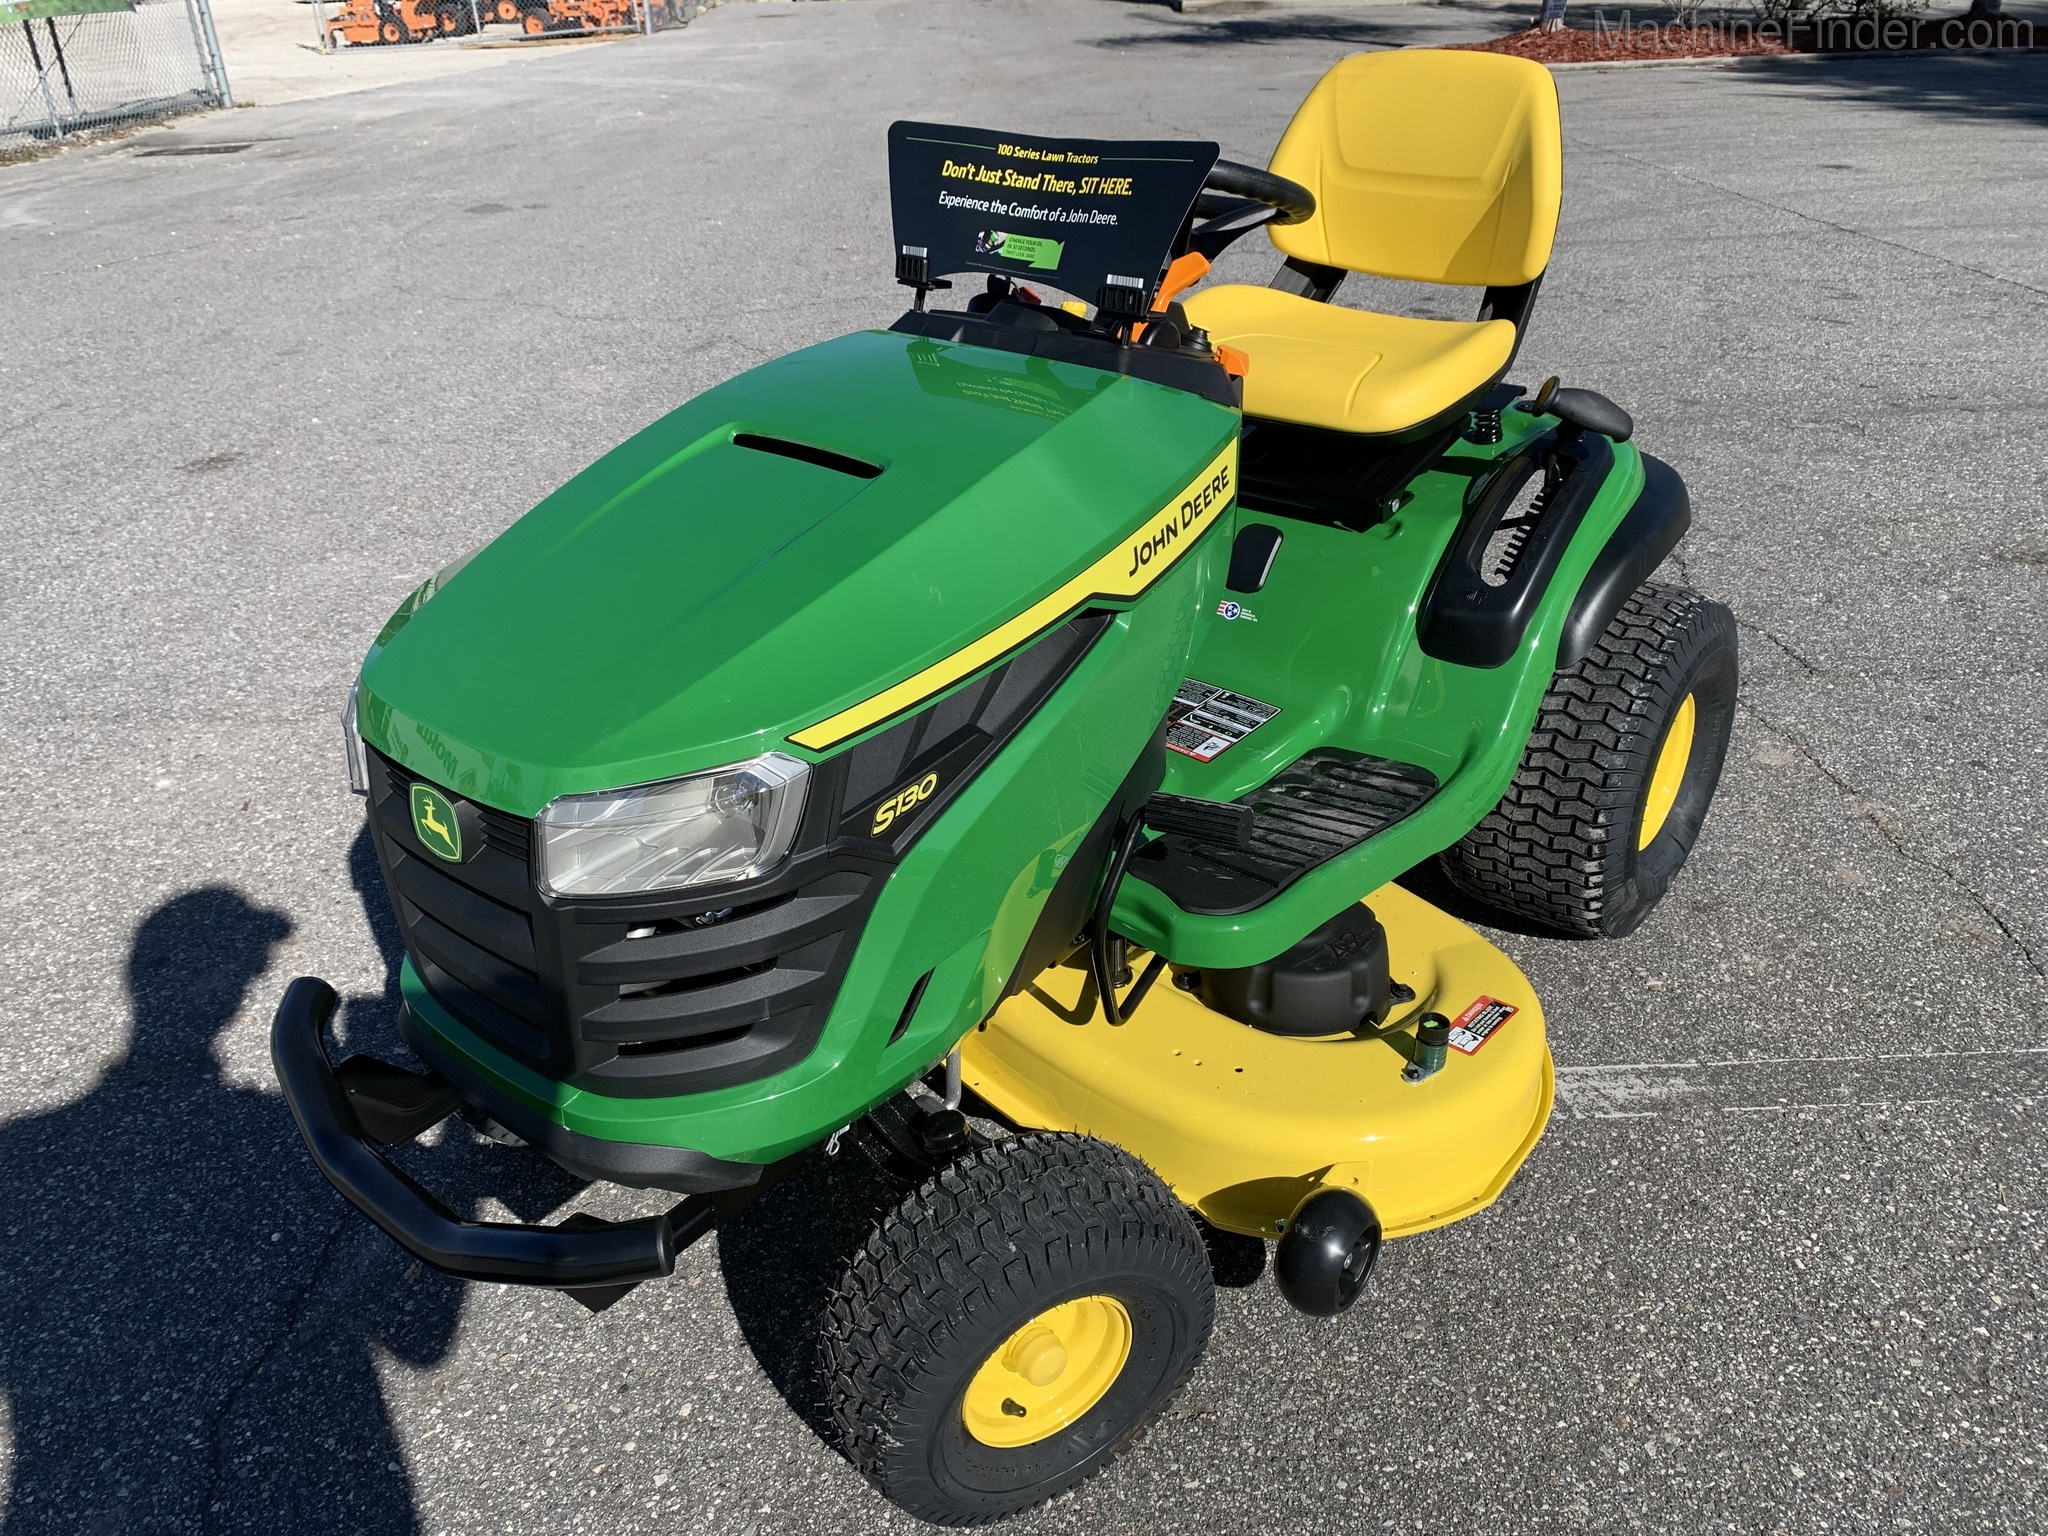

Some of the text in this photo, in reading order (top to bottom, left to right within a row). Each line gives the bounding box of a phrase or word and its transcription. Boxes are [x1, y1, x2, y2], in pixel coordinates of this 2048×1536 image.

[997, 143, 1099, 164] 100 Series Lawn Tractors
[942, 159, 1133, 196] Don't Just Stand There, SIT HERE.
[938, 190, 1118, 226] Experience the Comfort of a John Deere.
[1129, 464, 1230, 578] JOHN DEERE
[872, 773, 937, 835] S130
